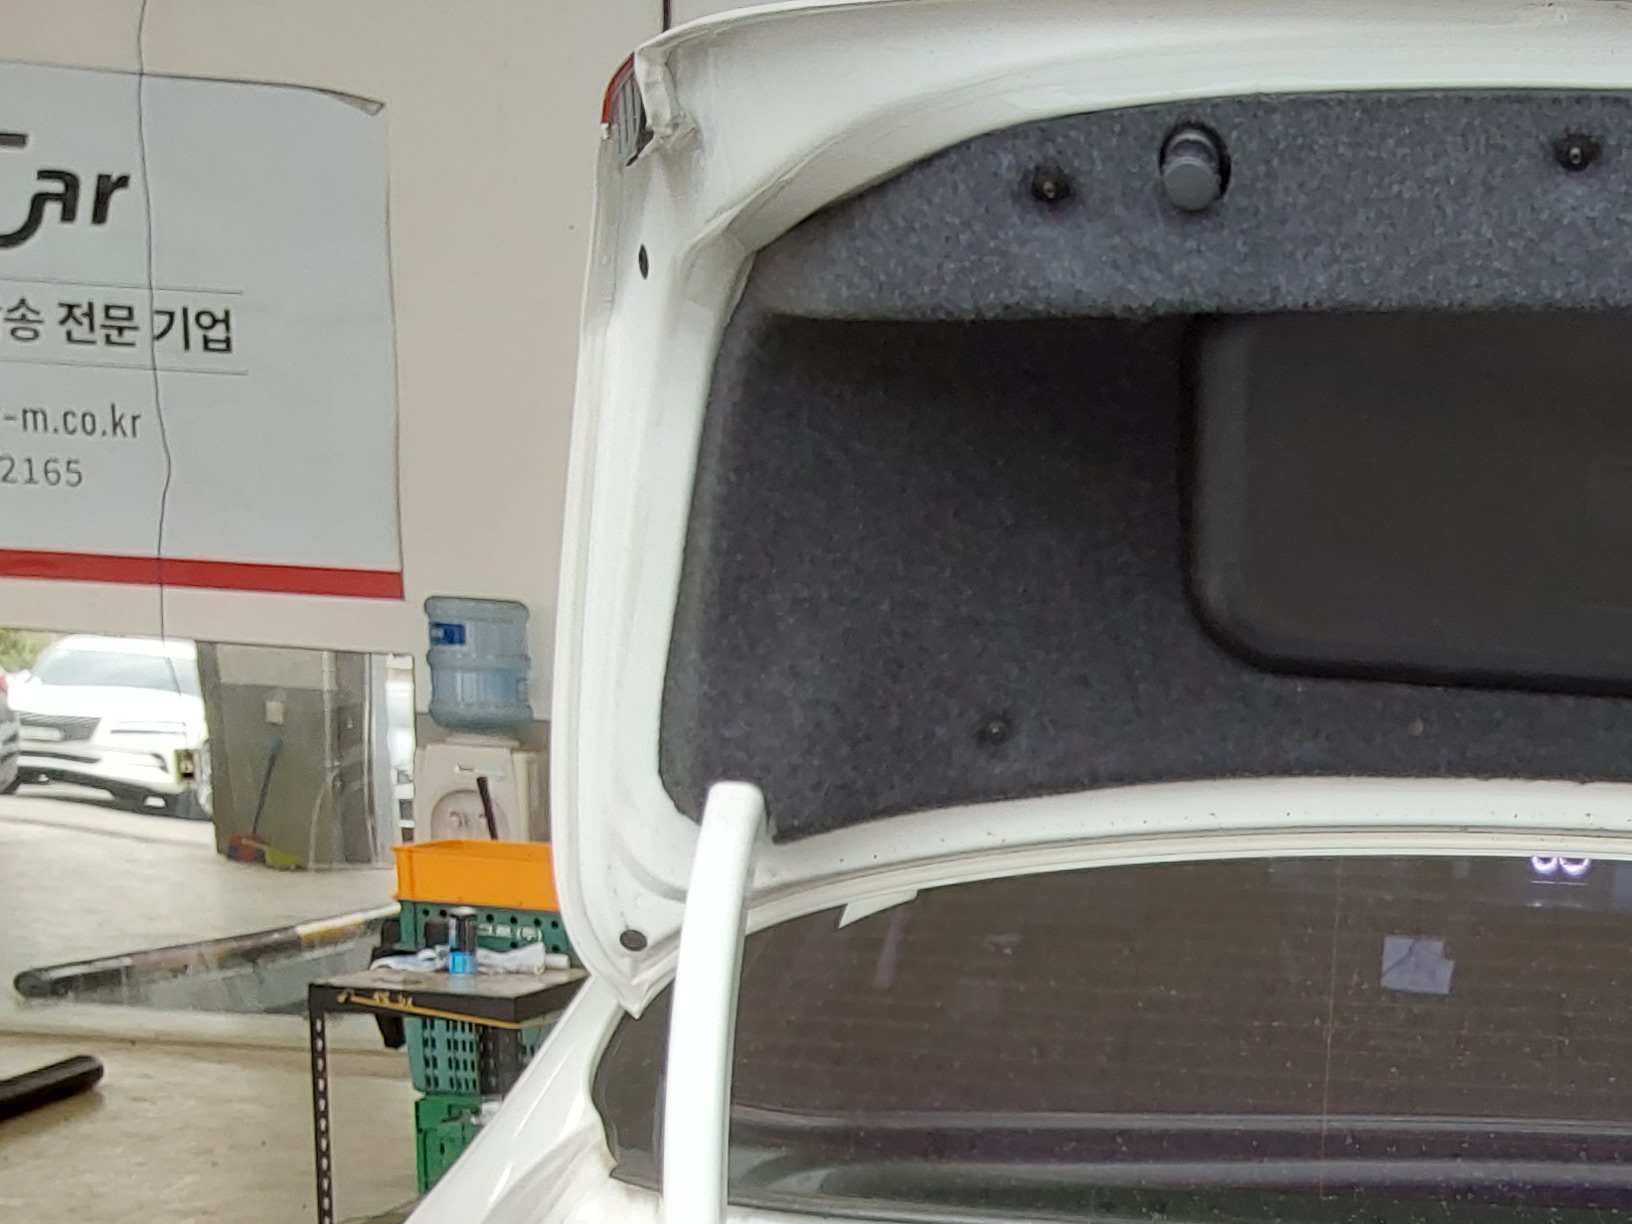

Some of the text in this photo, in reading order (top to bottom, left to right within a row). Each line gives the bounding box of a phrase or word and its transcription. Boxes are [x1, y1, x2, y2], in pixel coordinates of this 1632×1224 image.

[58, 301, 140, 347] 전문
[153, 306, 233, 354] 기업
[3, 402, 142, 438] -m.co.kr
[0, 455, 83, 487] 2165
